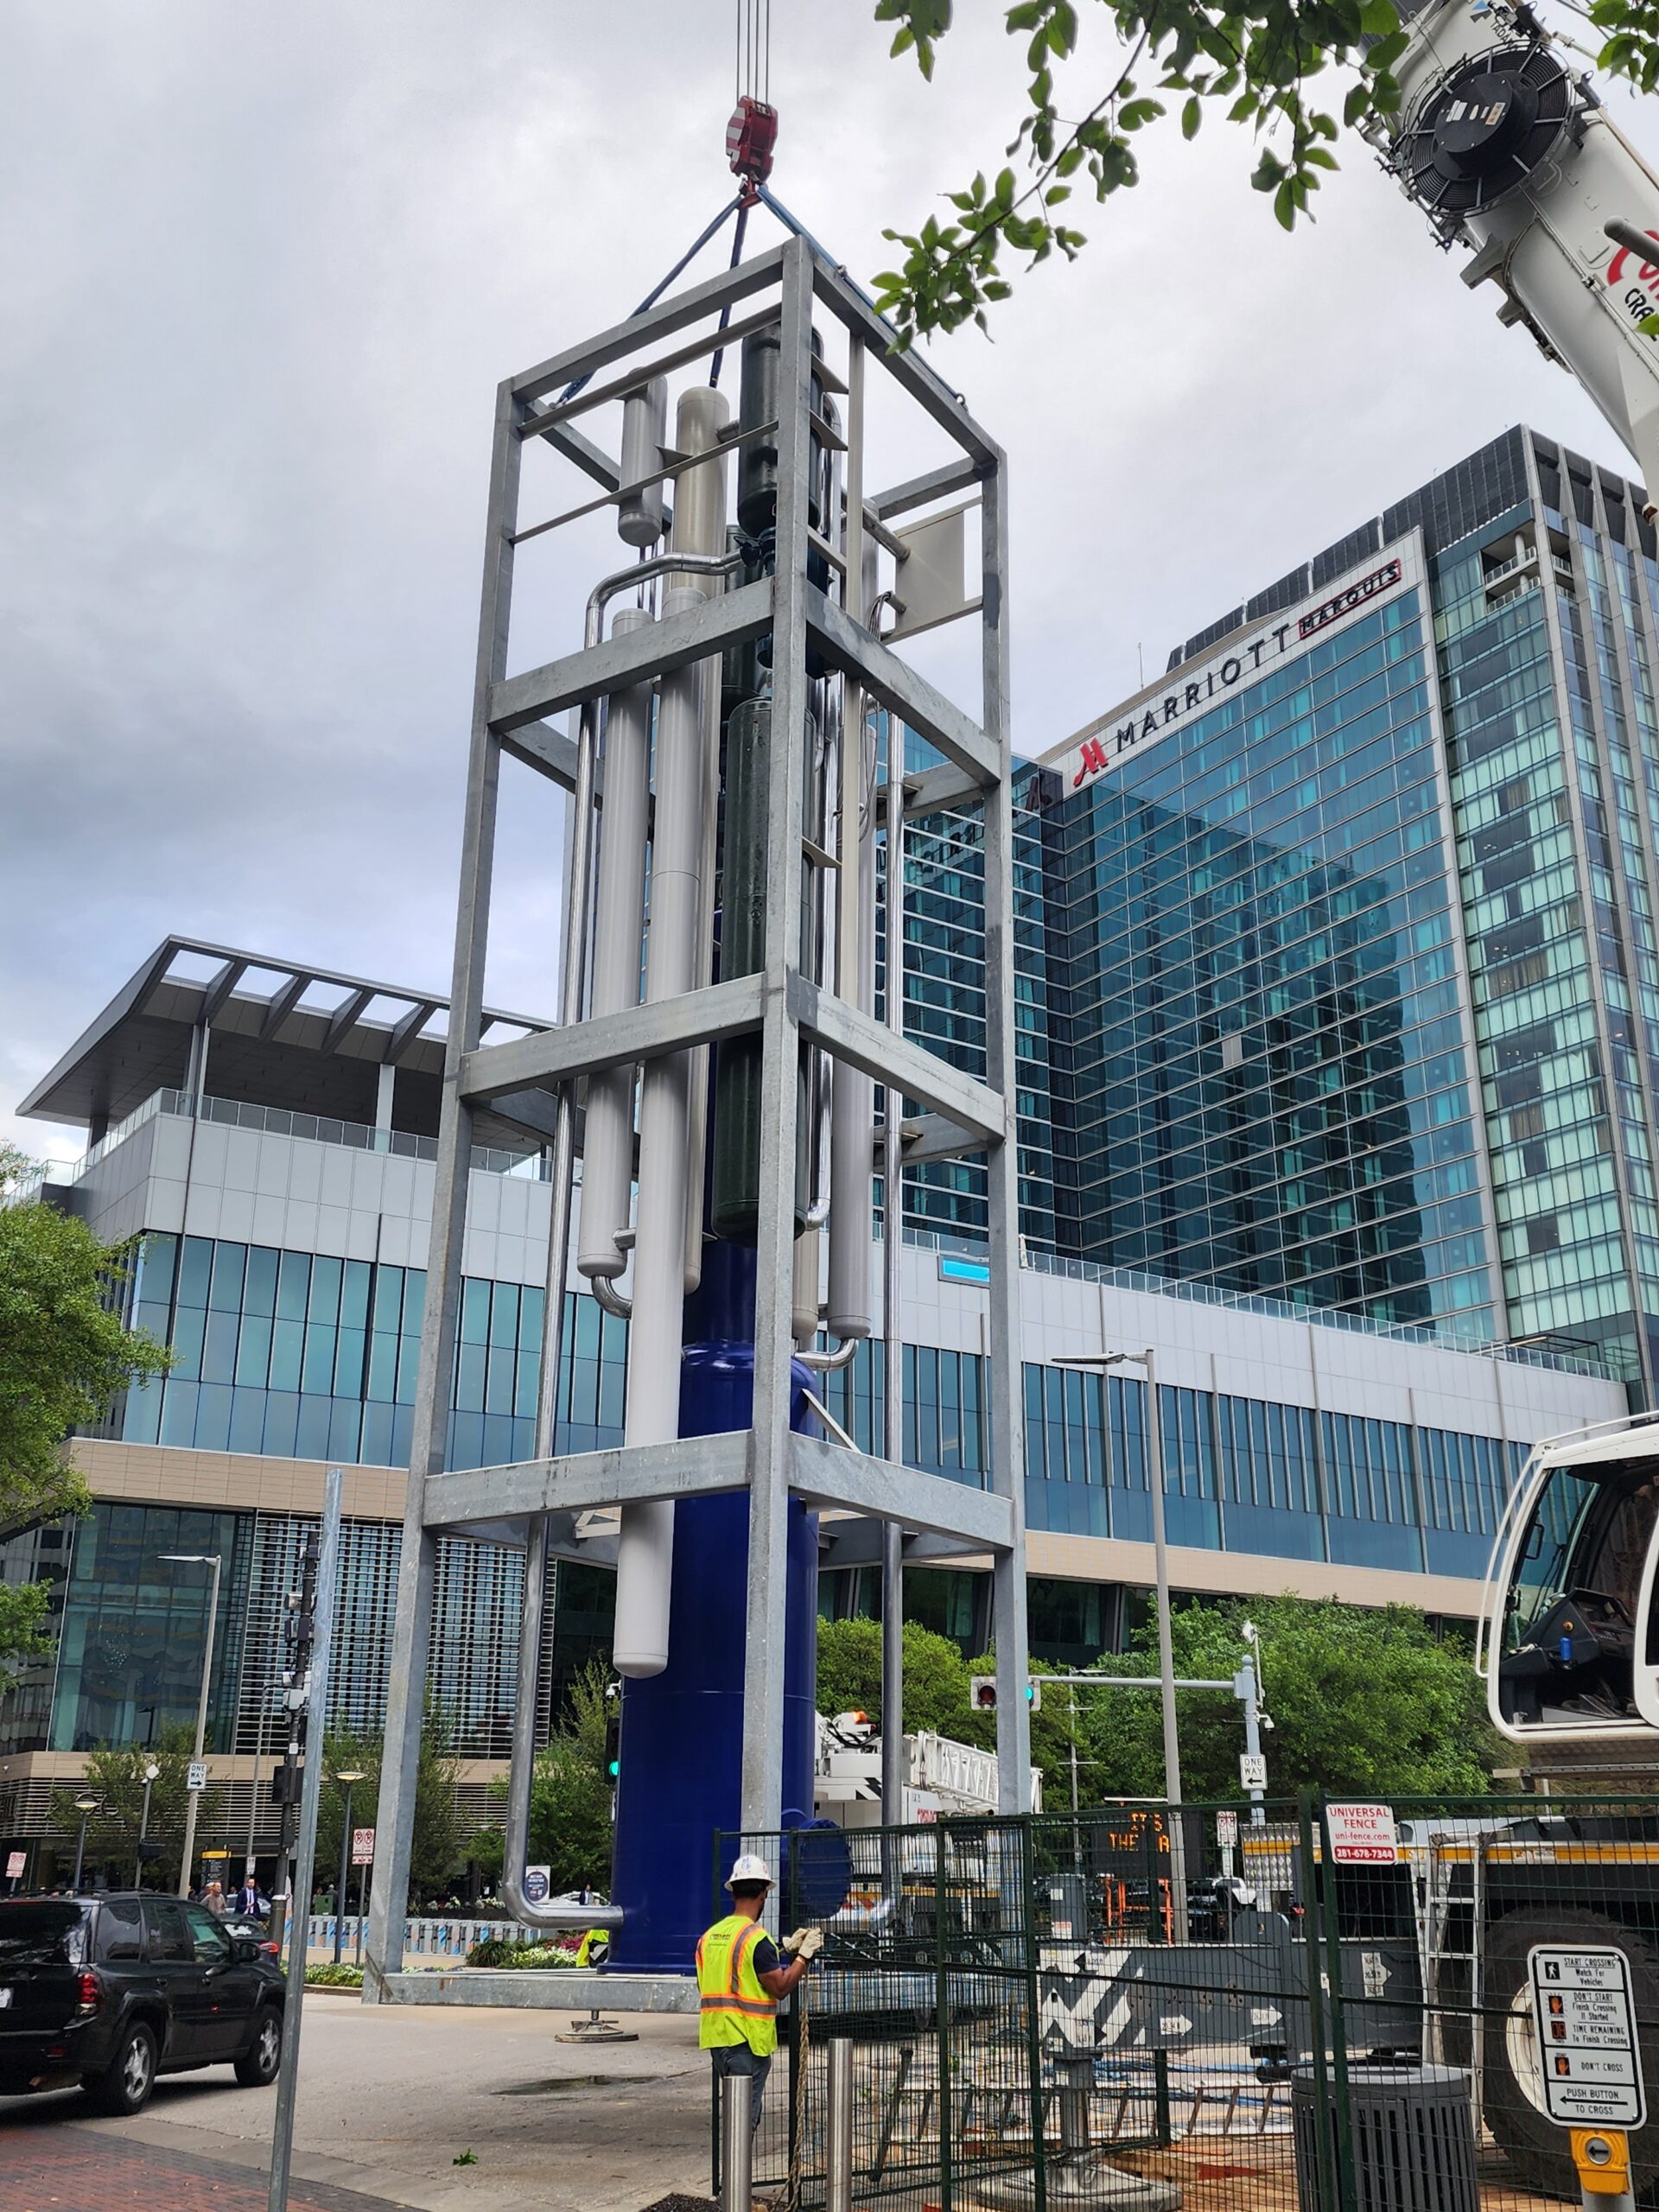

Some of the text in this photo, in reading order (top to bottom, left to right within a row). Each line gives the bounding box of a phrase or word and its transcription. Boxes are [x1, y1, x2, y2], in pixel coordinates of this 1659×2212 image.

[1625, 288, 1657, 342] CRA
[1116, 623, 1289, 753] MARRIOTT
[1302, 564, 1398, 633] MARQUIS
[1244, 1758, 1262, 1766] ONE
[1330, 1808, 1389, 1817] UNIVERSAL
[1344, 1819, 1377, 1829] FENCE
[1335, 1832, 1389, 1840] uni-fence.com
[1109, 1833, 1139, 1853] THE
[1336, 1848, 1393, 1859] 281-678-7344
[1564, 1957, 1616, 1967] START CROSSING
[1576, 1968, 1592, 1977] Watch
[1580, 1978, 1603, 1986] Vehicles
[1573, 1992, 1613, 2001] DON'T START
[1573, 2003, 1618, 2014] Finish Crossing
[1588, 2012, 1609, 2021] Started
[1573, 2024, 1624, 2035] TIME REMAINING
[1583, 2035, 1600, 2044] Finish
[1604, 2036, 1628, 2047] Crossing
[1580, 2062, 1624, 2072] DON'T CROSS
[1567, 2088, 1619, 2100] PUSH BUTTON
[1575, 2104, 1614, 2115] TO CROSS
